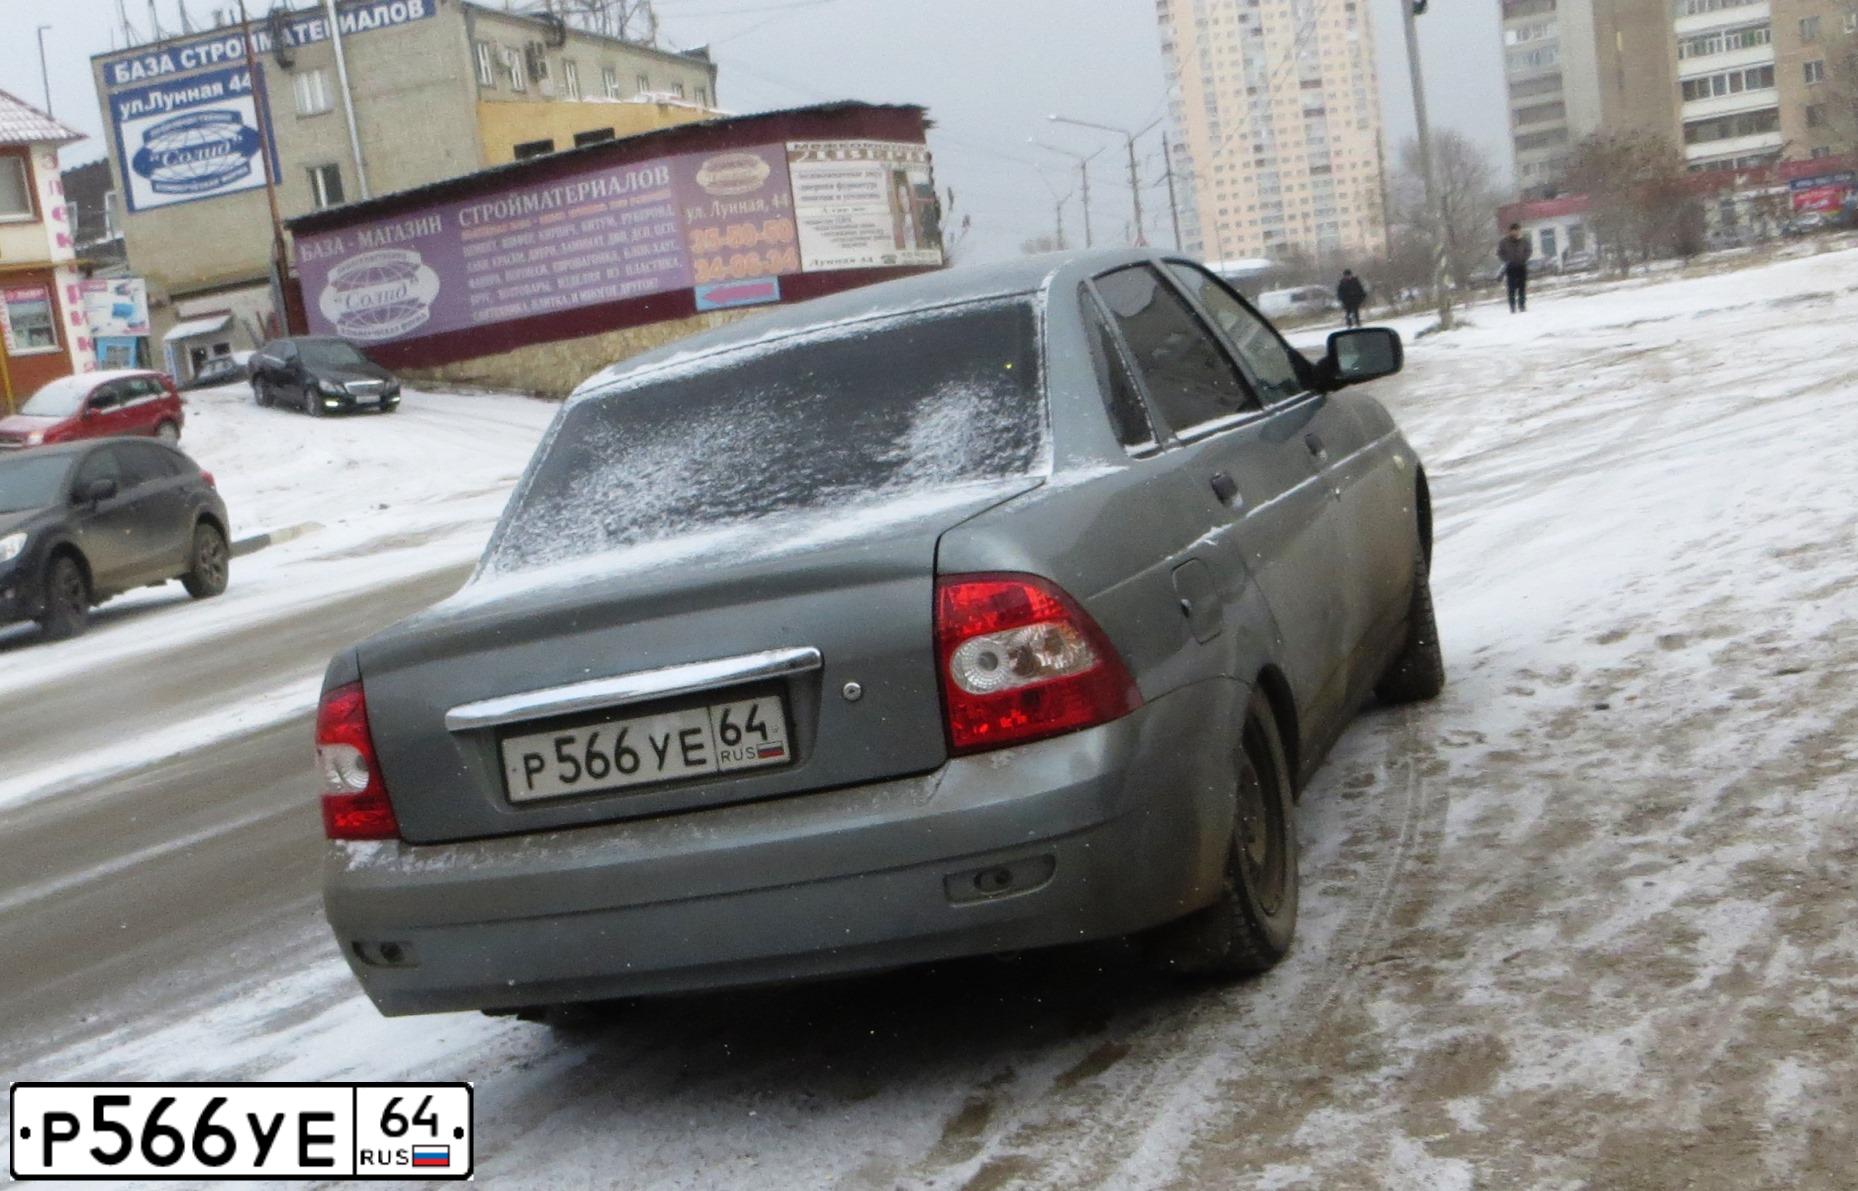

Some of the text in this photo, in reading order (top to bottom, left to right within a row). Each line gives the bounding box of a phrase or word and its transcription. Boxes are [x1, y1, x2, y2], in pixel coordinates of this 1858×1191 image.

[115, 54, 174, 84] БАЗА
[300, 236, 344, 263] БАЗА
[357, 215, 442, 248] МАГАЗИН
[459, 165, 669, 227] СТРОЙМАТЕРИАЛОВ
[524, 704, 769, 790] Р566УЕ 64
[721, 747, 756, 763] RUS
